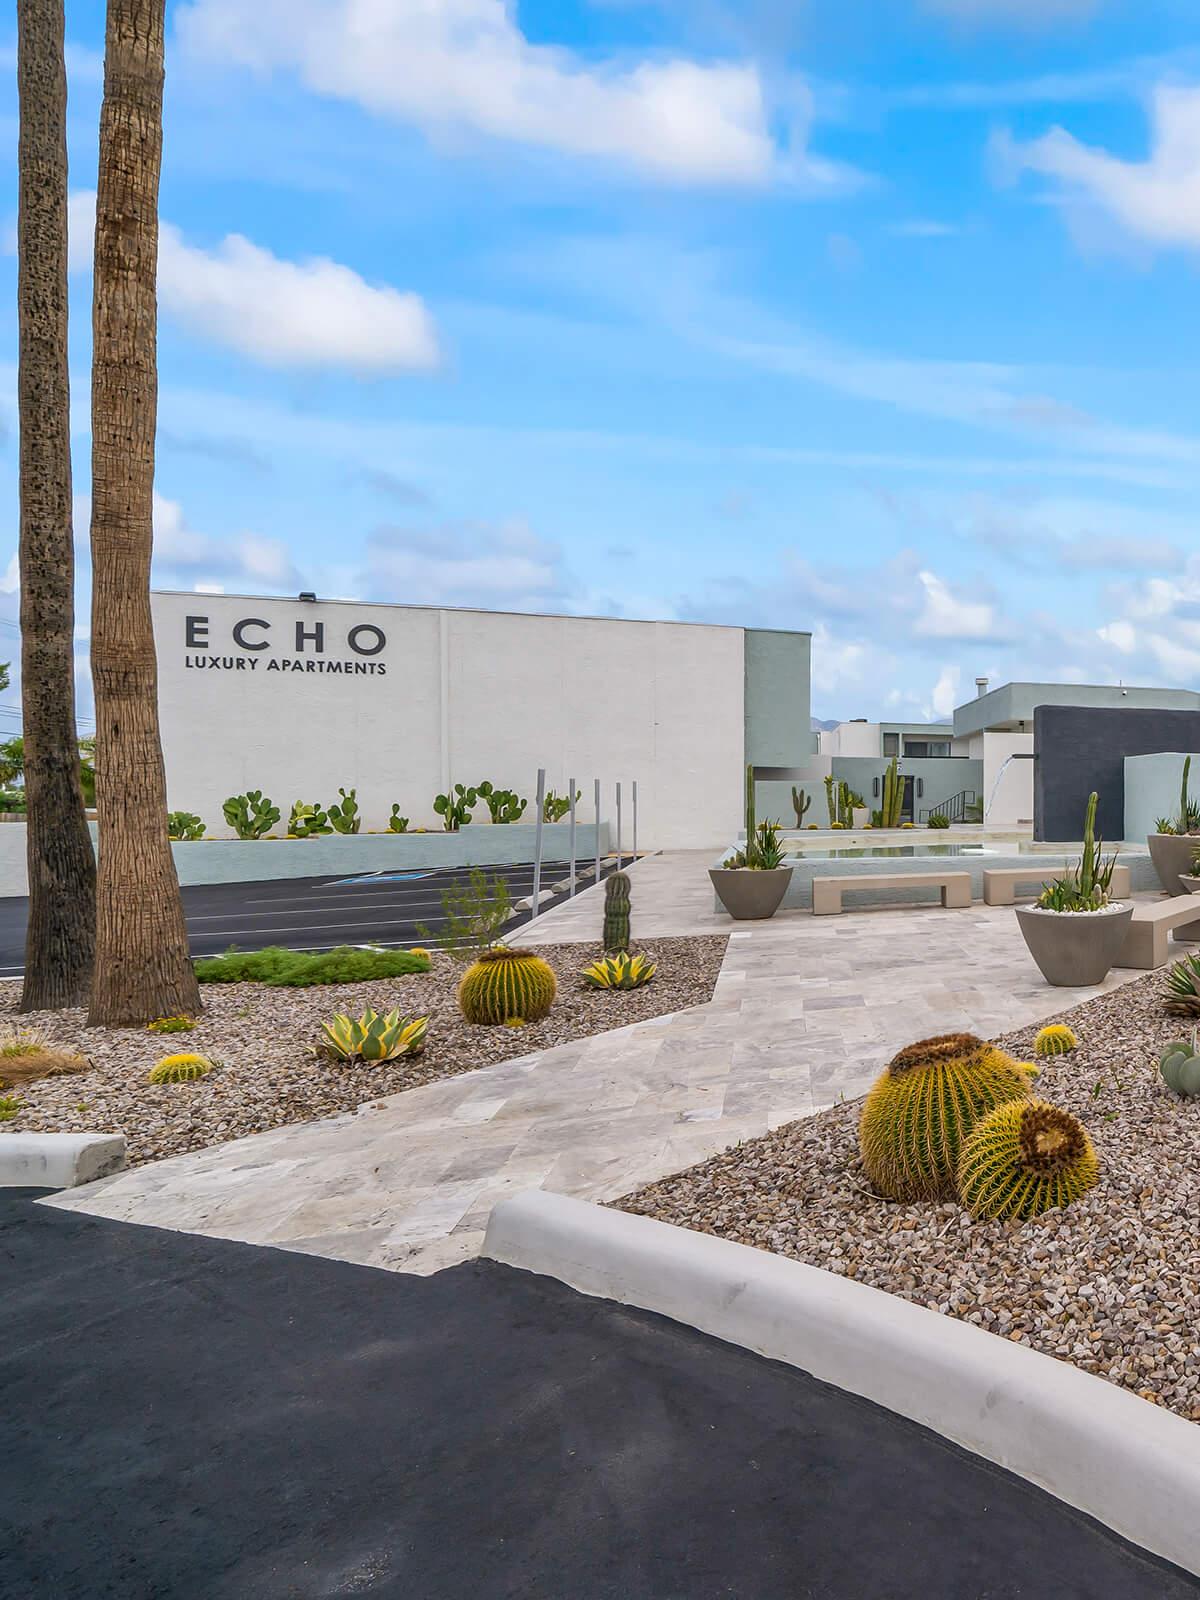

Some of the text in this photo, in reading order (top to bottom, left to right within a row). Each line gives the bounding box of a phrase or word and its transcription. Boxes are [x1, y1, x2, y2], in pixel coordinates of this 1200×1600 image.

[185, 615, 387, 656] ECHO
[185, 655, 386, 675] LUXURY APARTMENTS
